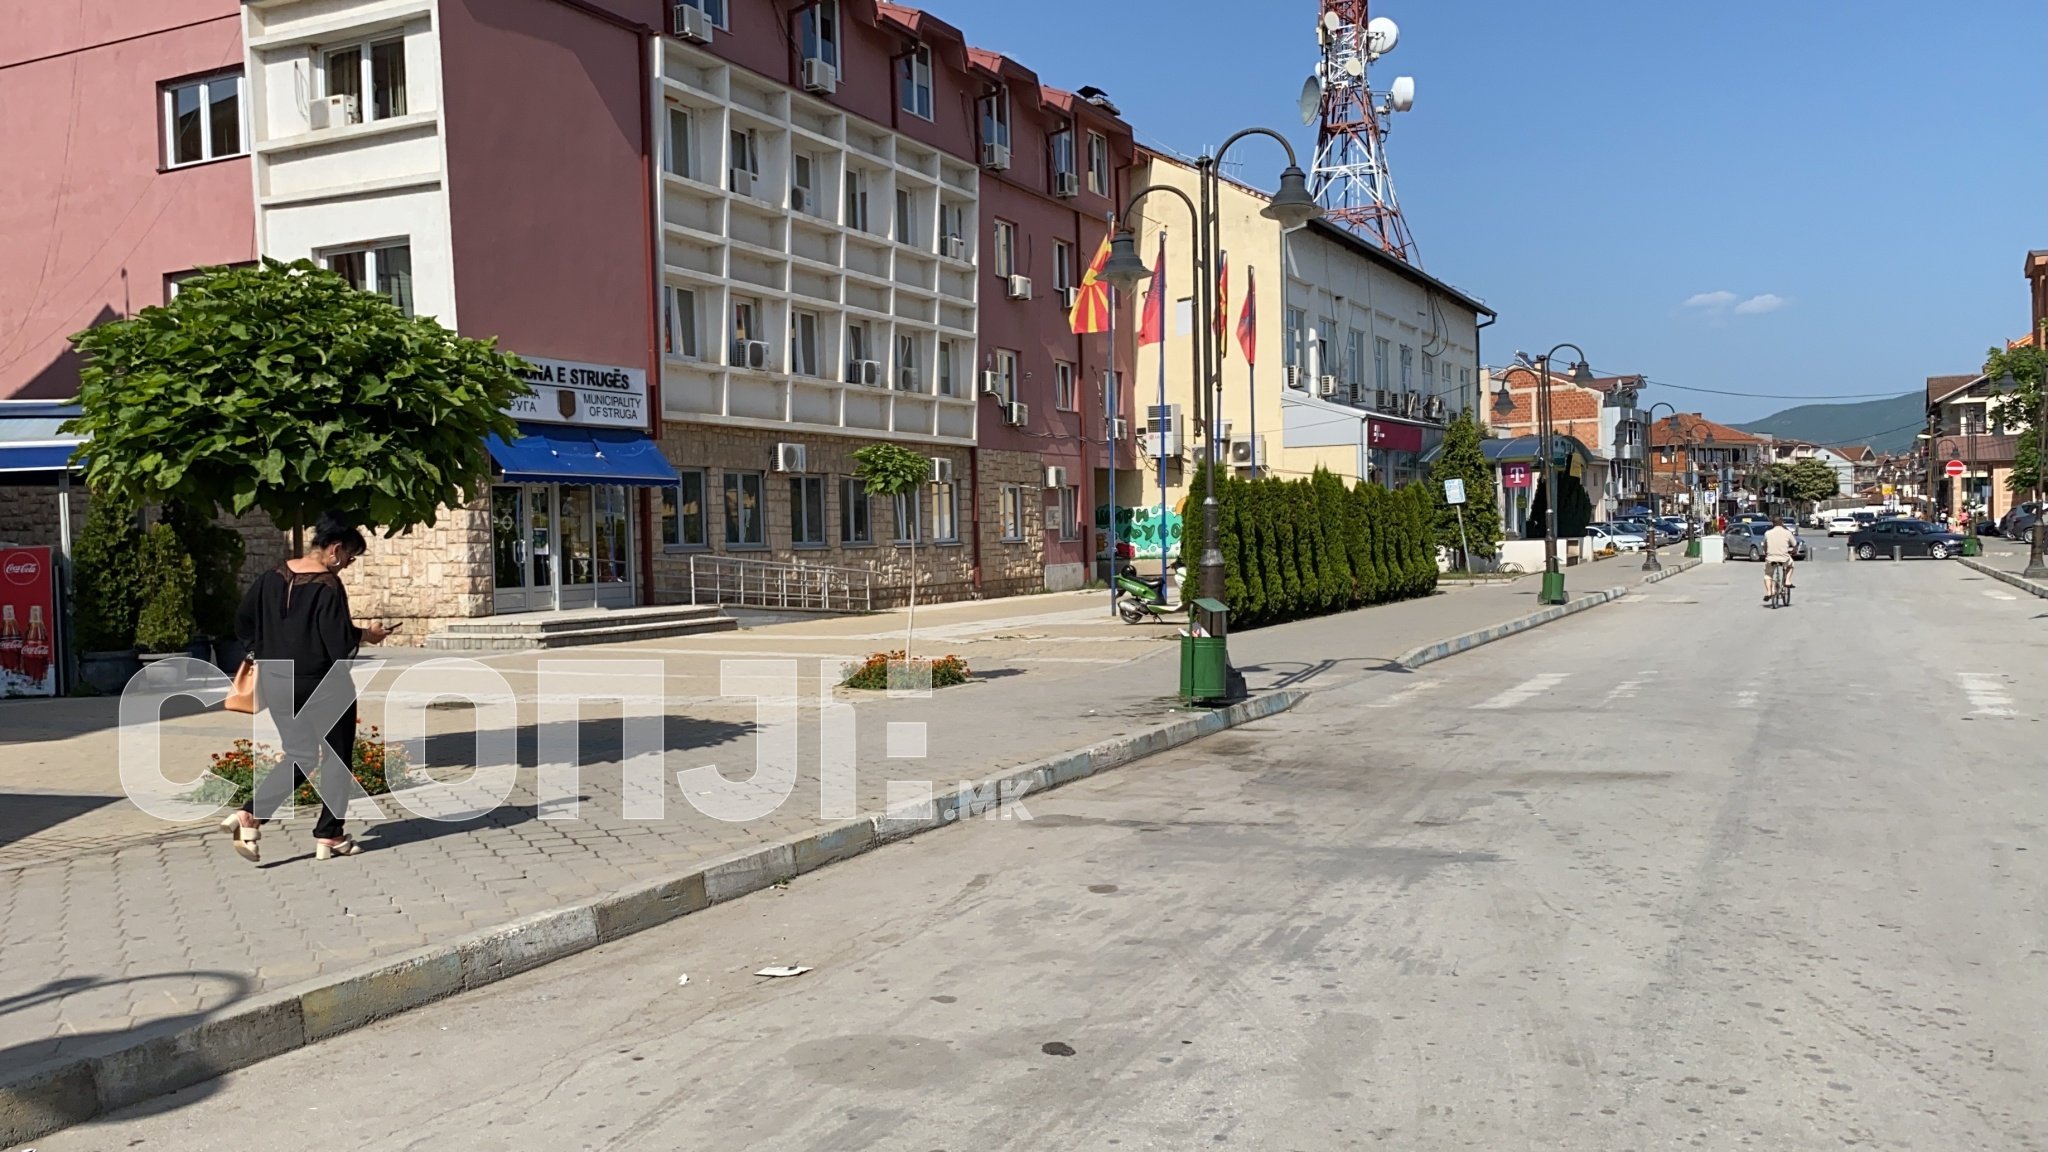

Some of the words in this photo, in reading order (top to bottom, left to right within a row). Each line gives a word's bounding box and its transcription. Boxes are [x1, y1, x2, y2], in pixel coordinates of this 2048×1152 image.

[557, 367, 566, 383] E
[583, 393, 641, 408] MUNICIPALITY
[589, 406, 601, 417] OF
[602, 408, 638, 420] STRUGA
[5, 563, 37, 574] Coca-Cola
